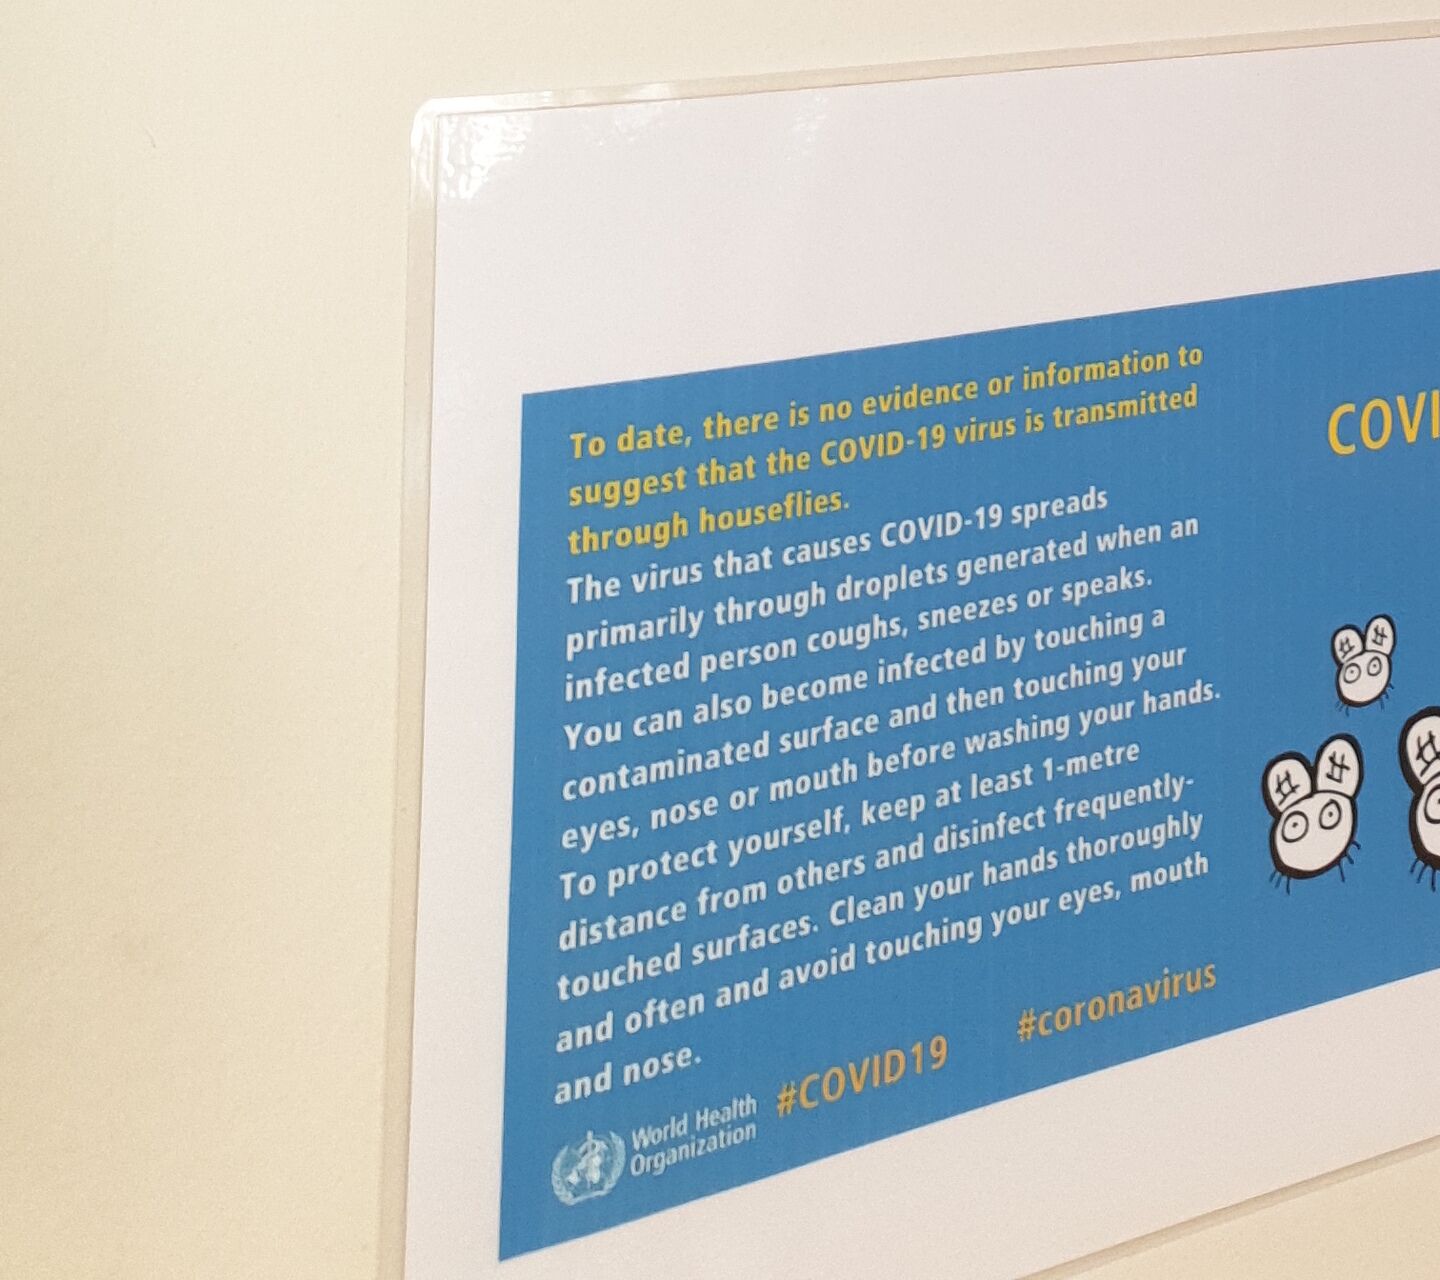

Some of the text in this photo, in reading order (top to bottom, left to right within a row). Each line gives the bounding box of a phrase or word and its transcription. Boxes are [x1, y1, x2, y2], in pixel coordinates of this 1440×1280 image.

[570, 346, 1202, 458] To date, there is no evidence or information to
[567, 486, 1108, 604] The virus that causes COVID-19 spreads
[568, 490, 849, 555] through houseflies.
[777, 964, 1216, 1117] #COVID19 #coronavirus
[555, 1047, 701, 1104] and nose.
[631, 1124, 756, 1175] Organization
[632, 1094, 756, 1151] World Health
